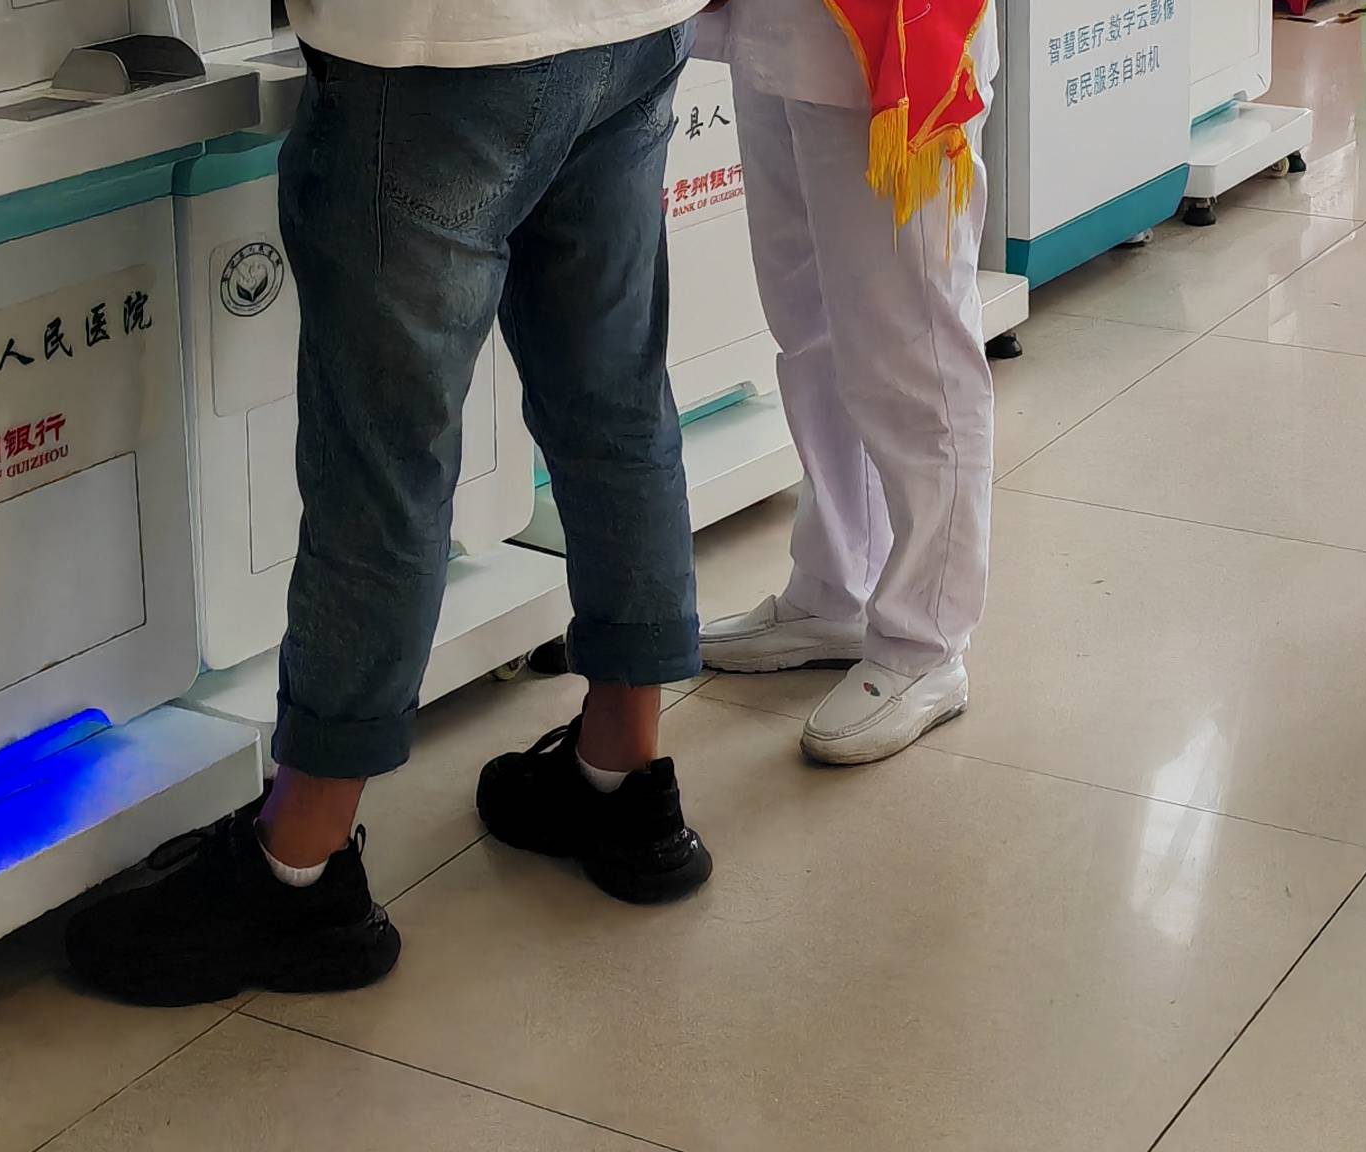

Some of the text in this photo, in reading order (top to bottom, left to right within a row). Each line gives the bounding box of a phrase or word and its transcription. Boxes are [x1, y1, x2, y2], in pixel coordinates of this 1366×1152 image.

[1065, 45, 1161, 107] 便民服务自助机
[674, 105, 730, 140] 县人
[672, 164, 744, 203] 贵州银行
[7, 444, 70, 479] GUIZHOU
